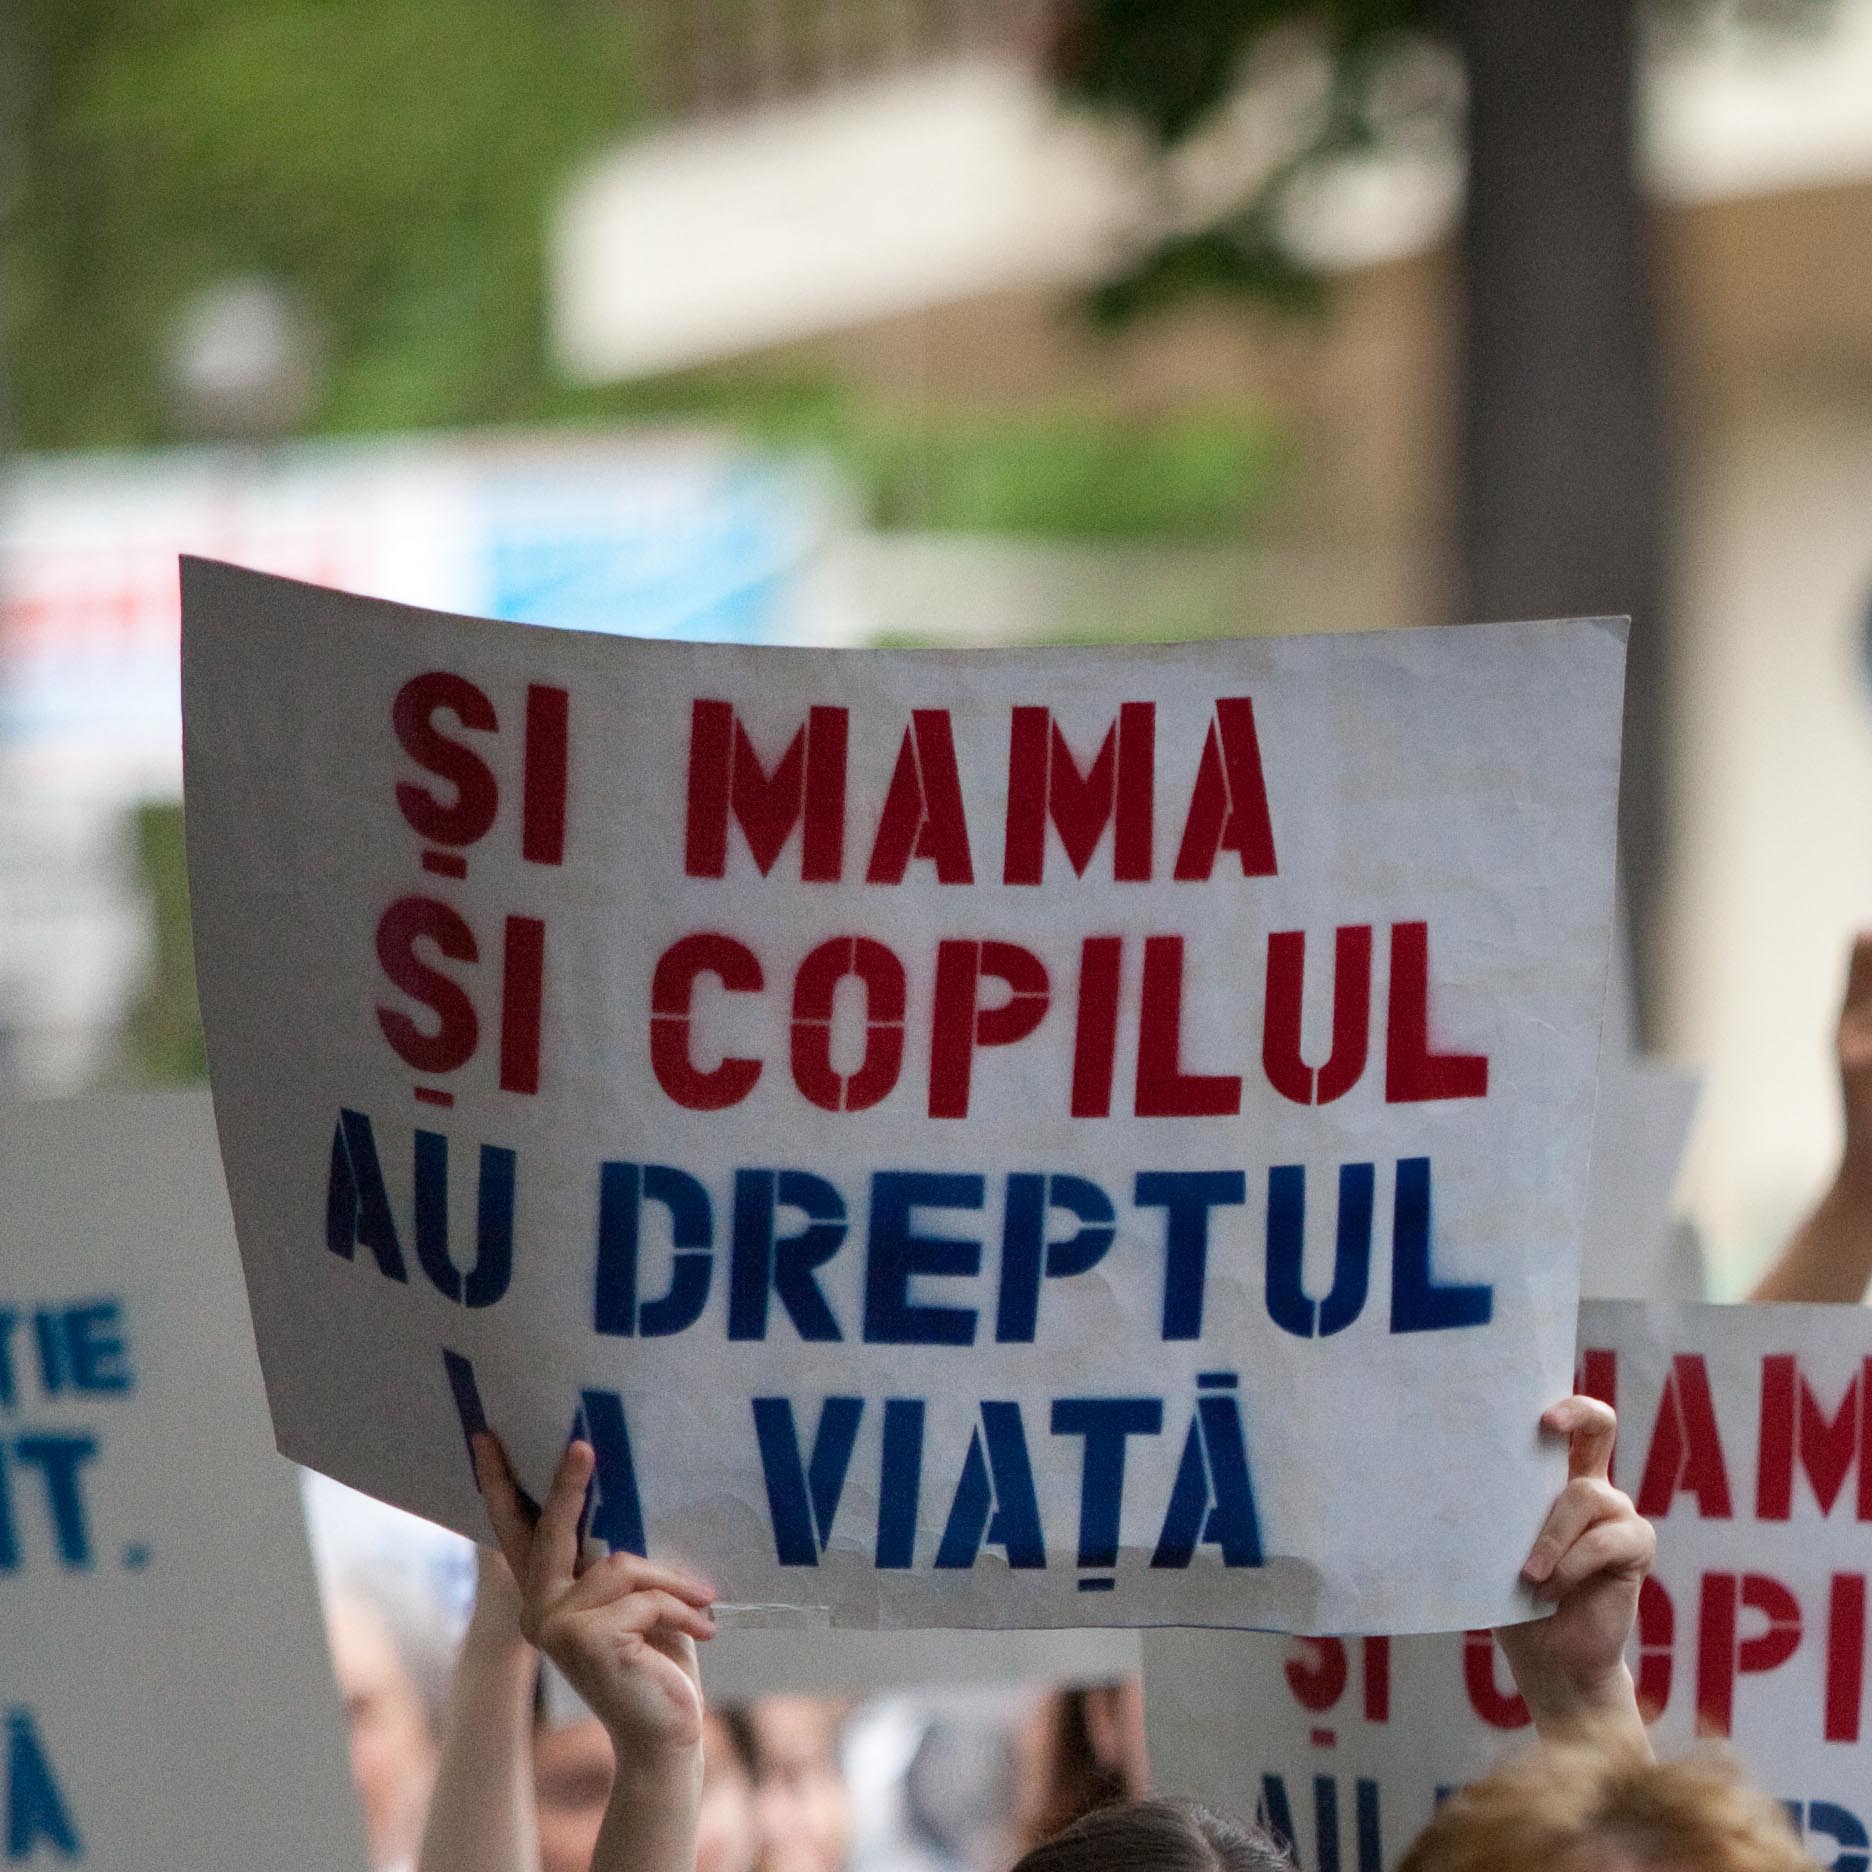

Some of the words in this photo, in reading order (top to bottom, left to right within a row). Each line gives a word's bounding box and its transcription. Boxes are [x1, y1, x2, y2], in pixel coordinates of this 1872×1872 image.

[684, 695, 1279, 886] MAMA
[648, 920, 1490, 1120] COPILUL
[326, 1106, 520, 1310] AU
[593, 1153, 1499, 1347] DREPTUL
